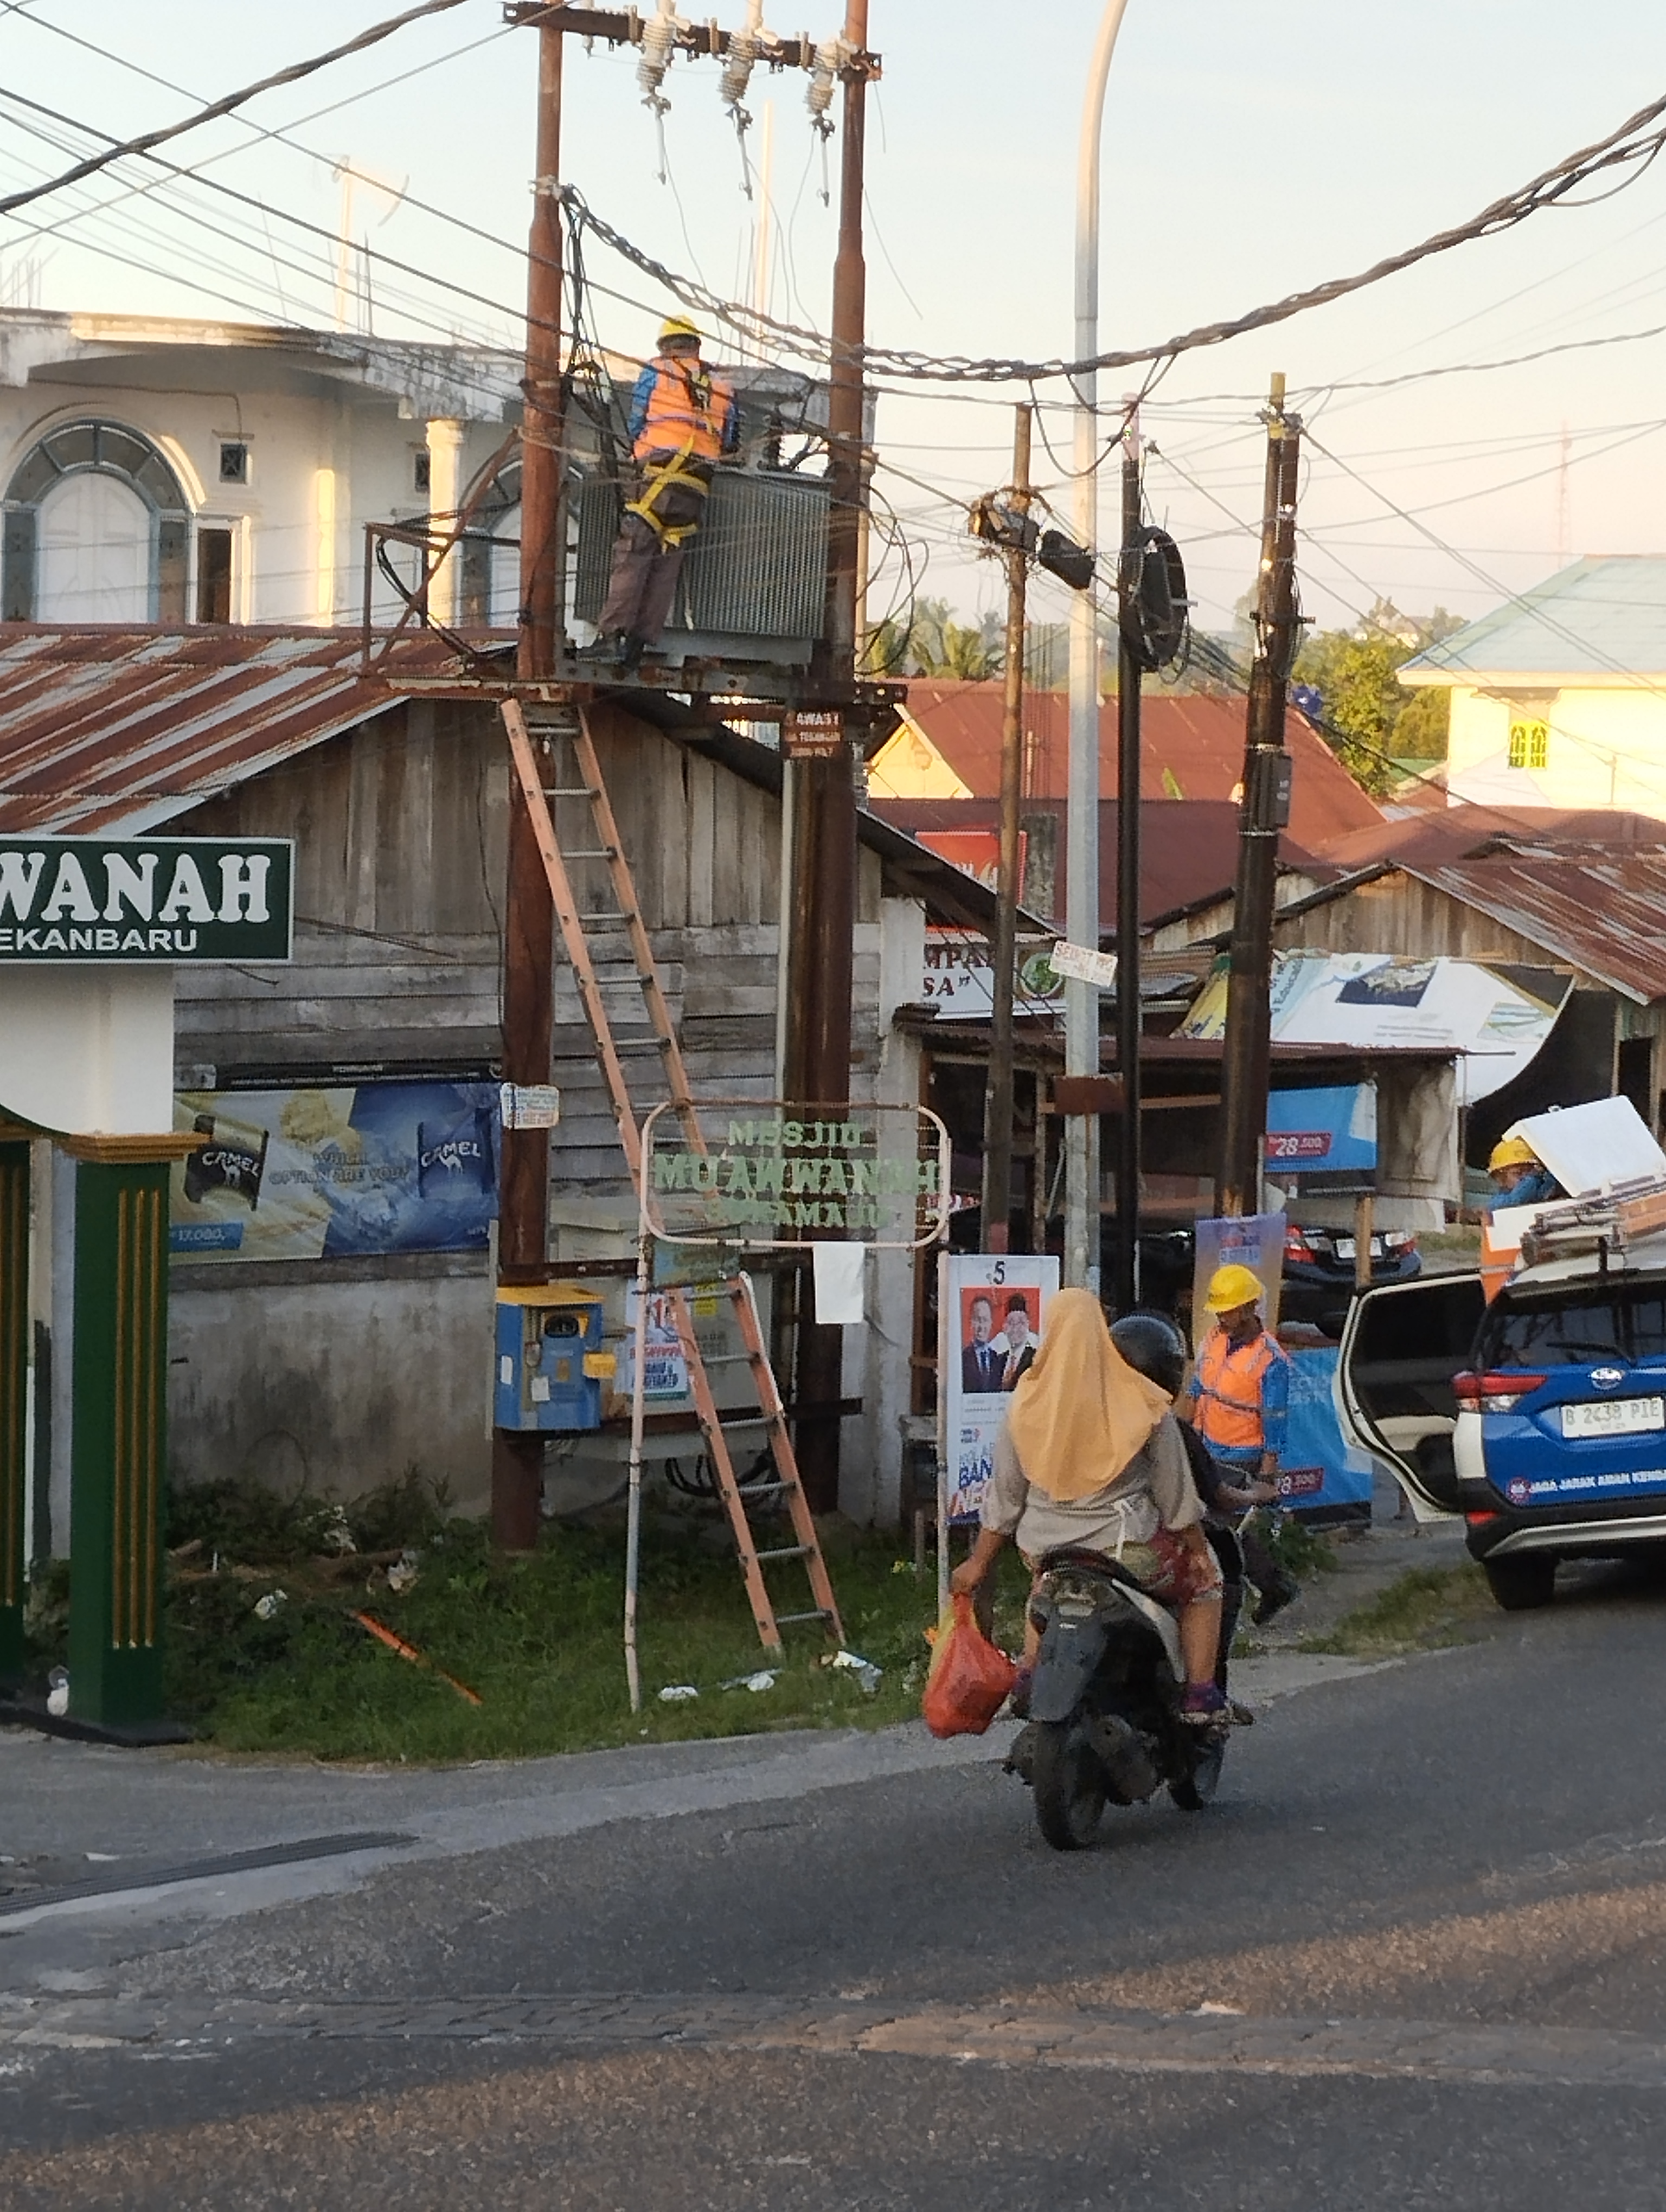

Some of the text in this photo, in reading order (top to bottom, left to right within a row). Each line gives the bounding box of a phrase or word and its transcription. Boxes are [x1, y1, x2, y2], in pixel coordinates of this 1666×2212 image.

[0, 852, 271, 922] WANAH
[202, 1152, 259, 1177] CAMEL
[421, 1141, 480, 1167] CAMEL
[992, 1260, 1005, 1285] 5
[1566, 1409, 1575, 1425] B
[1630, 1400, 1660, 1419] PIE
